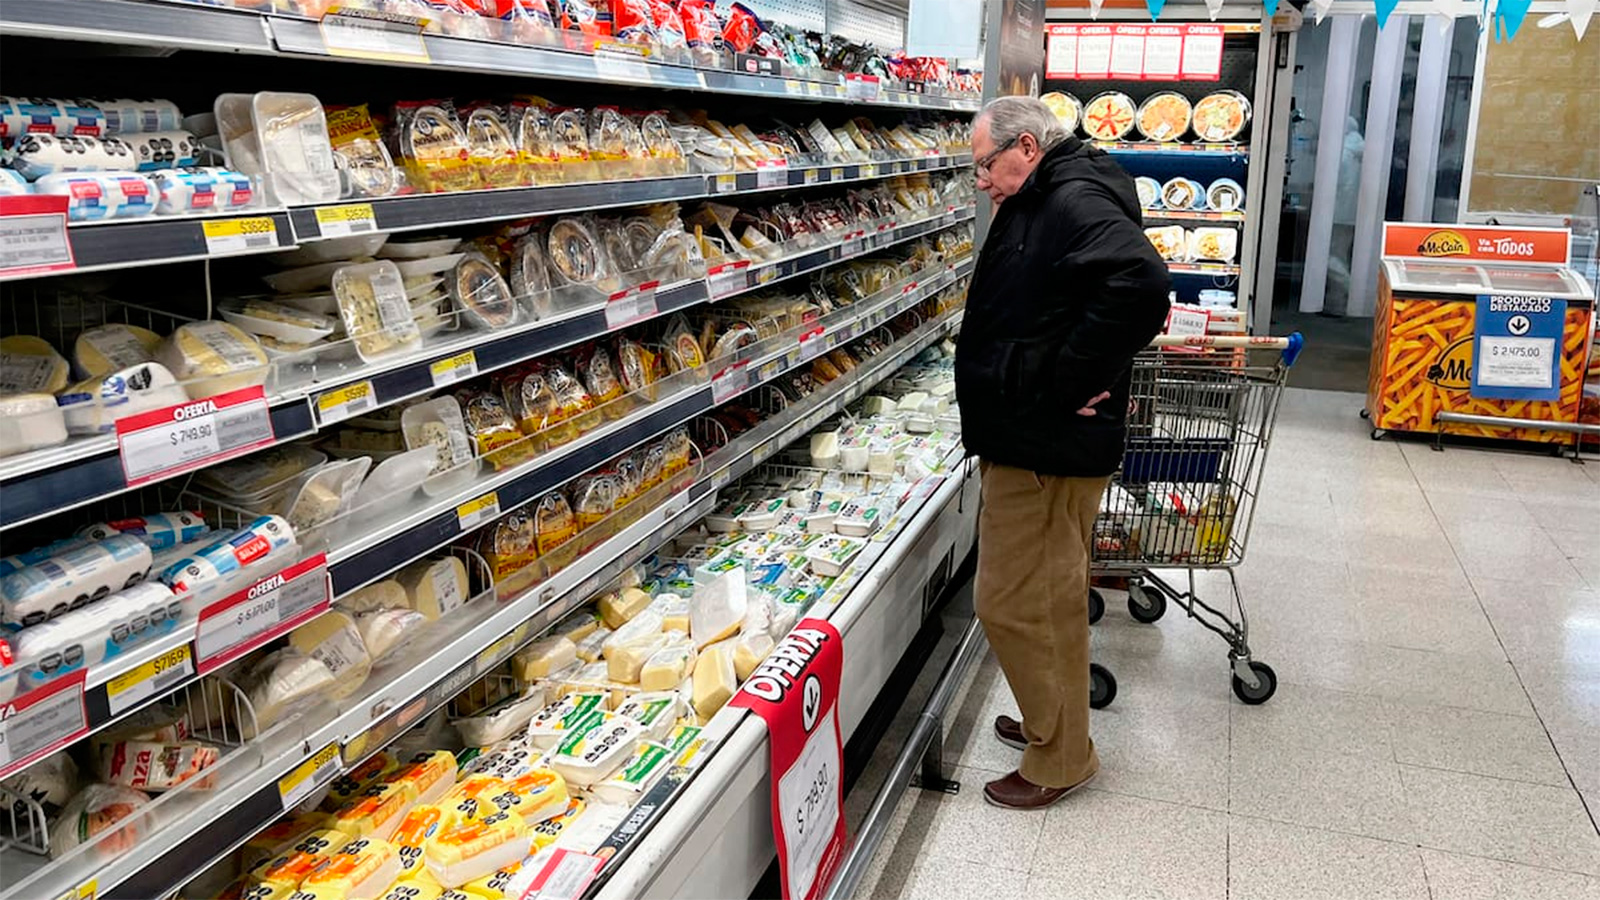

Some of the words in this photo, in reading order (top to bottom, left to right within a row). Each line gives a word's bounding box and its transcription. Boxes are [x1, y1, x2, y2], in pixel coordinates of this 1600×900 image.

[1080, 26, 1112, 34] OFERTA
[1148, 26, 1180, 35] OFERTA
[1188, 26, 1220, 34] OFERTA
[1426, 240, 1464, 254] McCain
[1478, 238, 1491, 246] Va
[1493, 238, 1534, 256] TODOS
[1490, 295, 1552, 306] PRODUCTO
[1490, 303, 1551, 313] DESTACADO
[173, 400, 219, 422] OFERTA
[237, 539, 268, 560] SILVIA
[247, 574, 286, 600] OFERTA
[743, 628, 830, 701] OFERTA
